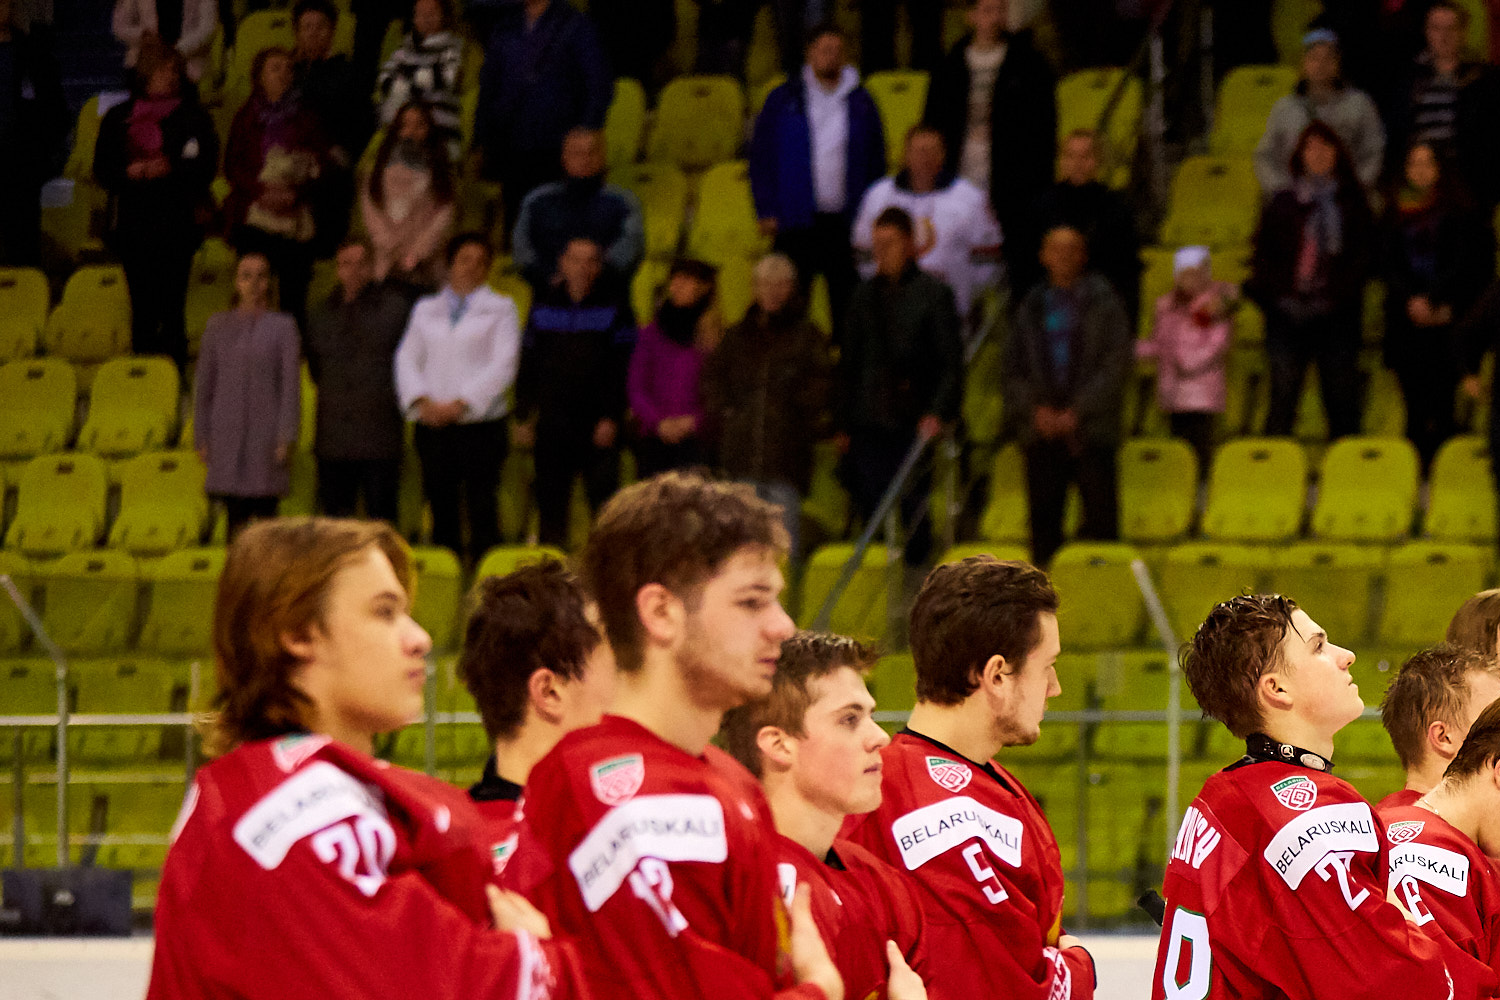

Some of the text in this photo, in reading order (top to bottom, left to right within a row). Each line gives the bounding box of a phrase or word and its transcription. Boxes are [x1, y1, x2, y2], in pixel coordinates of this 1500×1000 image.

[311, 814, 397, 896] 20
[961, 842, 1009, 905] 5
[1275, 819, 1373, 876] BELARUSKALI
[1388, 852, 1465, 882] ARUSKALI
[1314, 850, 1371, 912] 2
